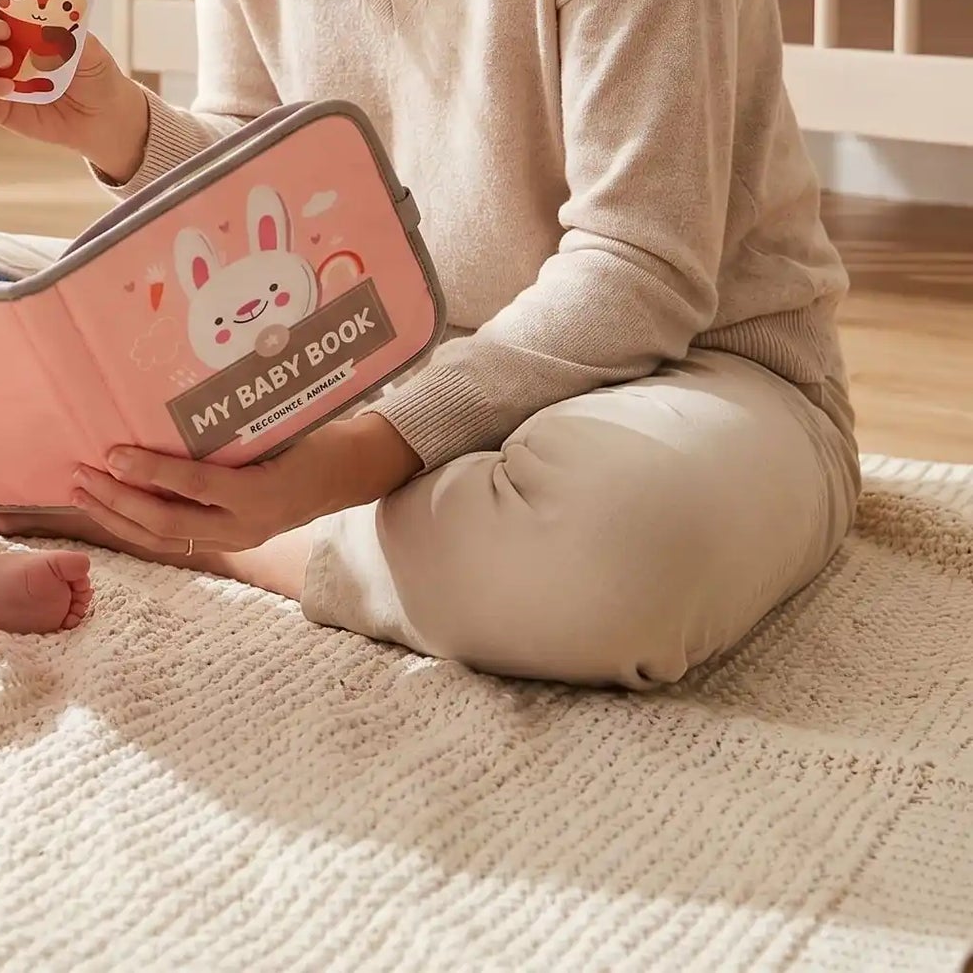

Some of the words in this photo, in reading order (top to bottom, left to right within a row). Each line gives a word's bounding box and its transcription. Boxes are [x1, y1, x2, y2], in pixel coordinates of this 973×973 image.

[190, 395, 230, 435] MY
[235, 353, 301, 410] BABY
[304, 307, 376, 367] BOOK
